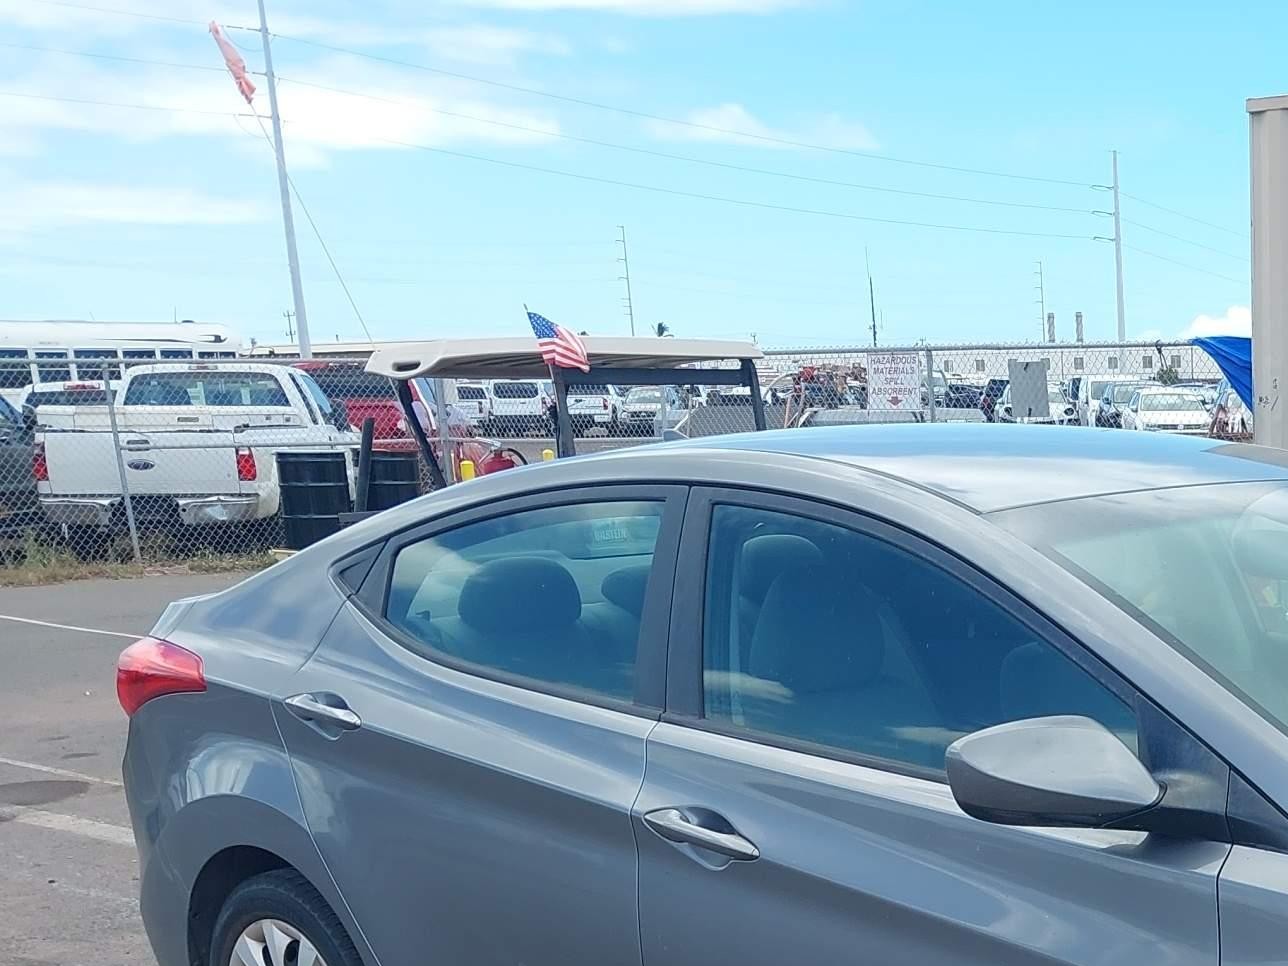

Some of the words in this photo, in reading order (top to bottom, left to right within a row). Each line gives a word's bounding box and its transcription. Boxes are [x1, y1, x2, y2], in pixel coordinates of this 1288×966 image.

[870, 356, 917, 364] HAZARDOUS
[873, 367, 915, 375] MATERIALS
[884, 377, 904, 385] SPILL
[871, 387, 917, 396] ABSORBENT
